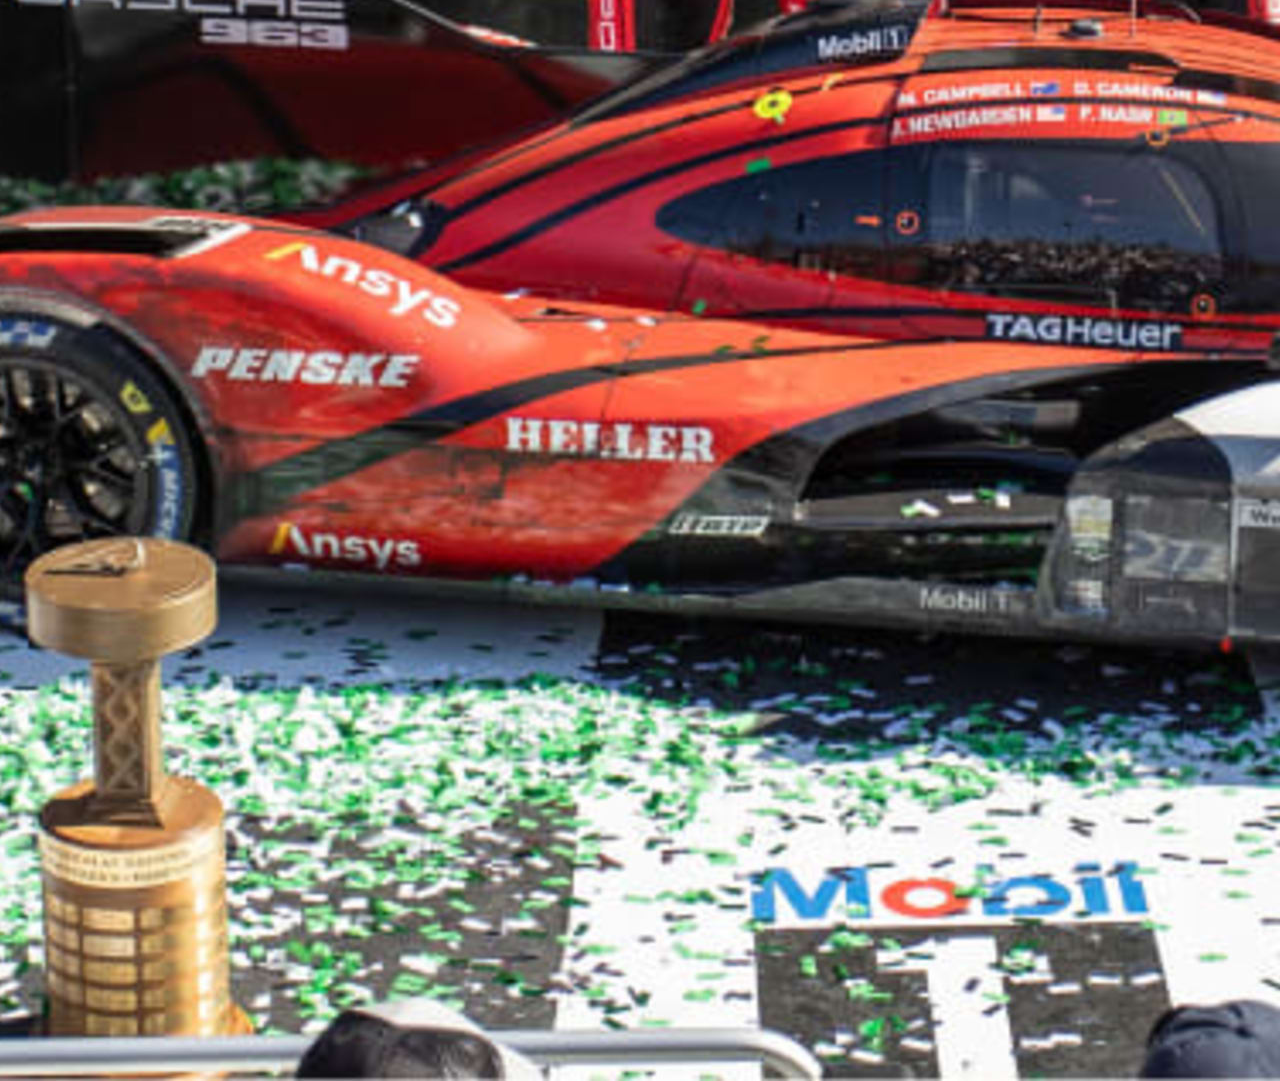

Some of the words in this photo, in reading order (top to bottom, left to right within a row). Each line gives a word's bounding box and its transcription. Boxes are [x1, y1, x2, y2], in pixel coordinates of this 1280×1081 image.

[200, 17, 351, 51] 963
[817, 29, 882, 61] Mobil
[264, 241, 463, 330] Ansys
[190, 346, 422, 389] PENSKE
[505, 417, 715, 464] HELLER
[269, 520, 424, 571] Ansys
[920, 585, 986, 613] Mobil
[749, 861, 1151, 924] Mobil
